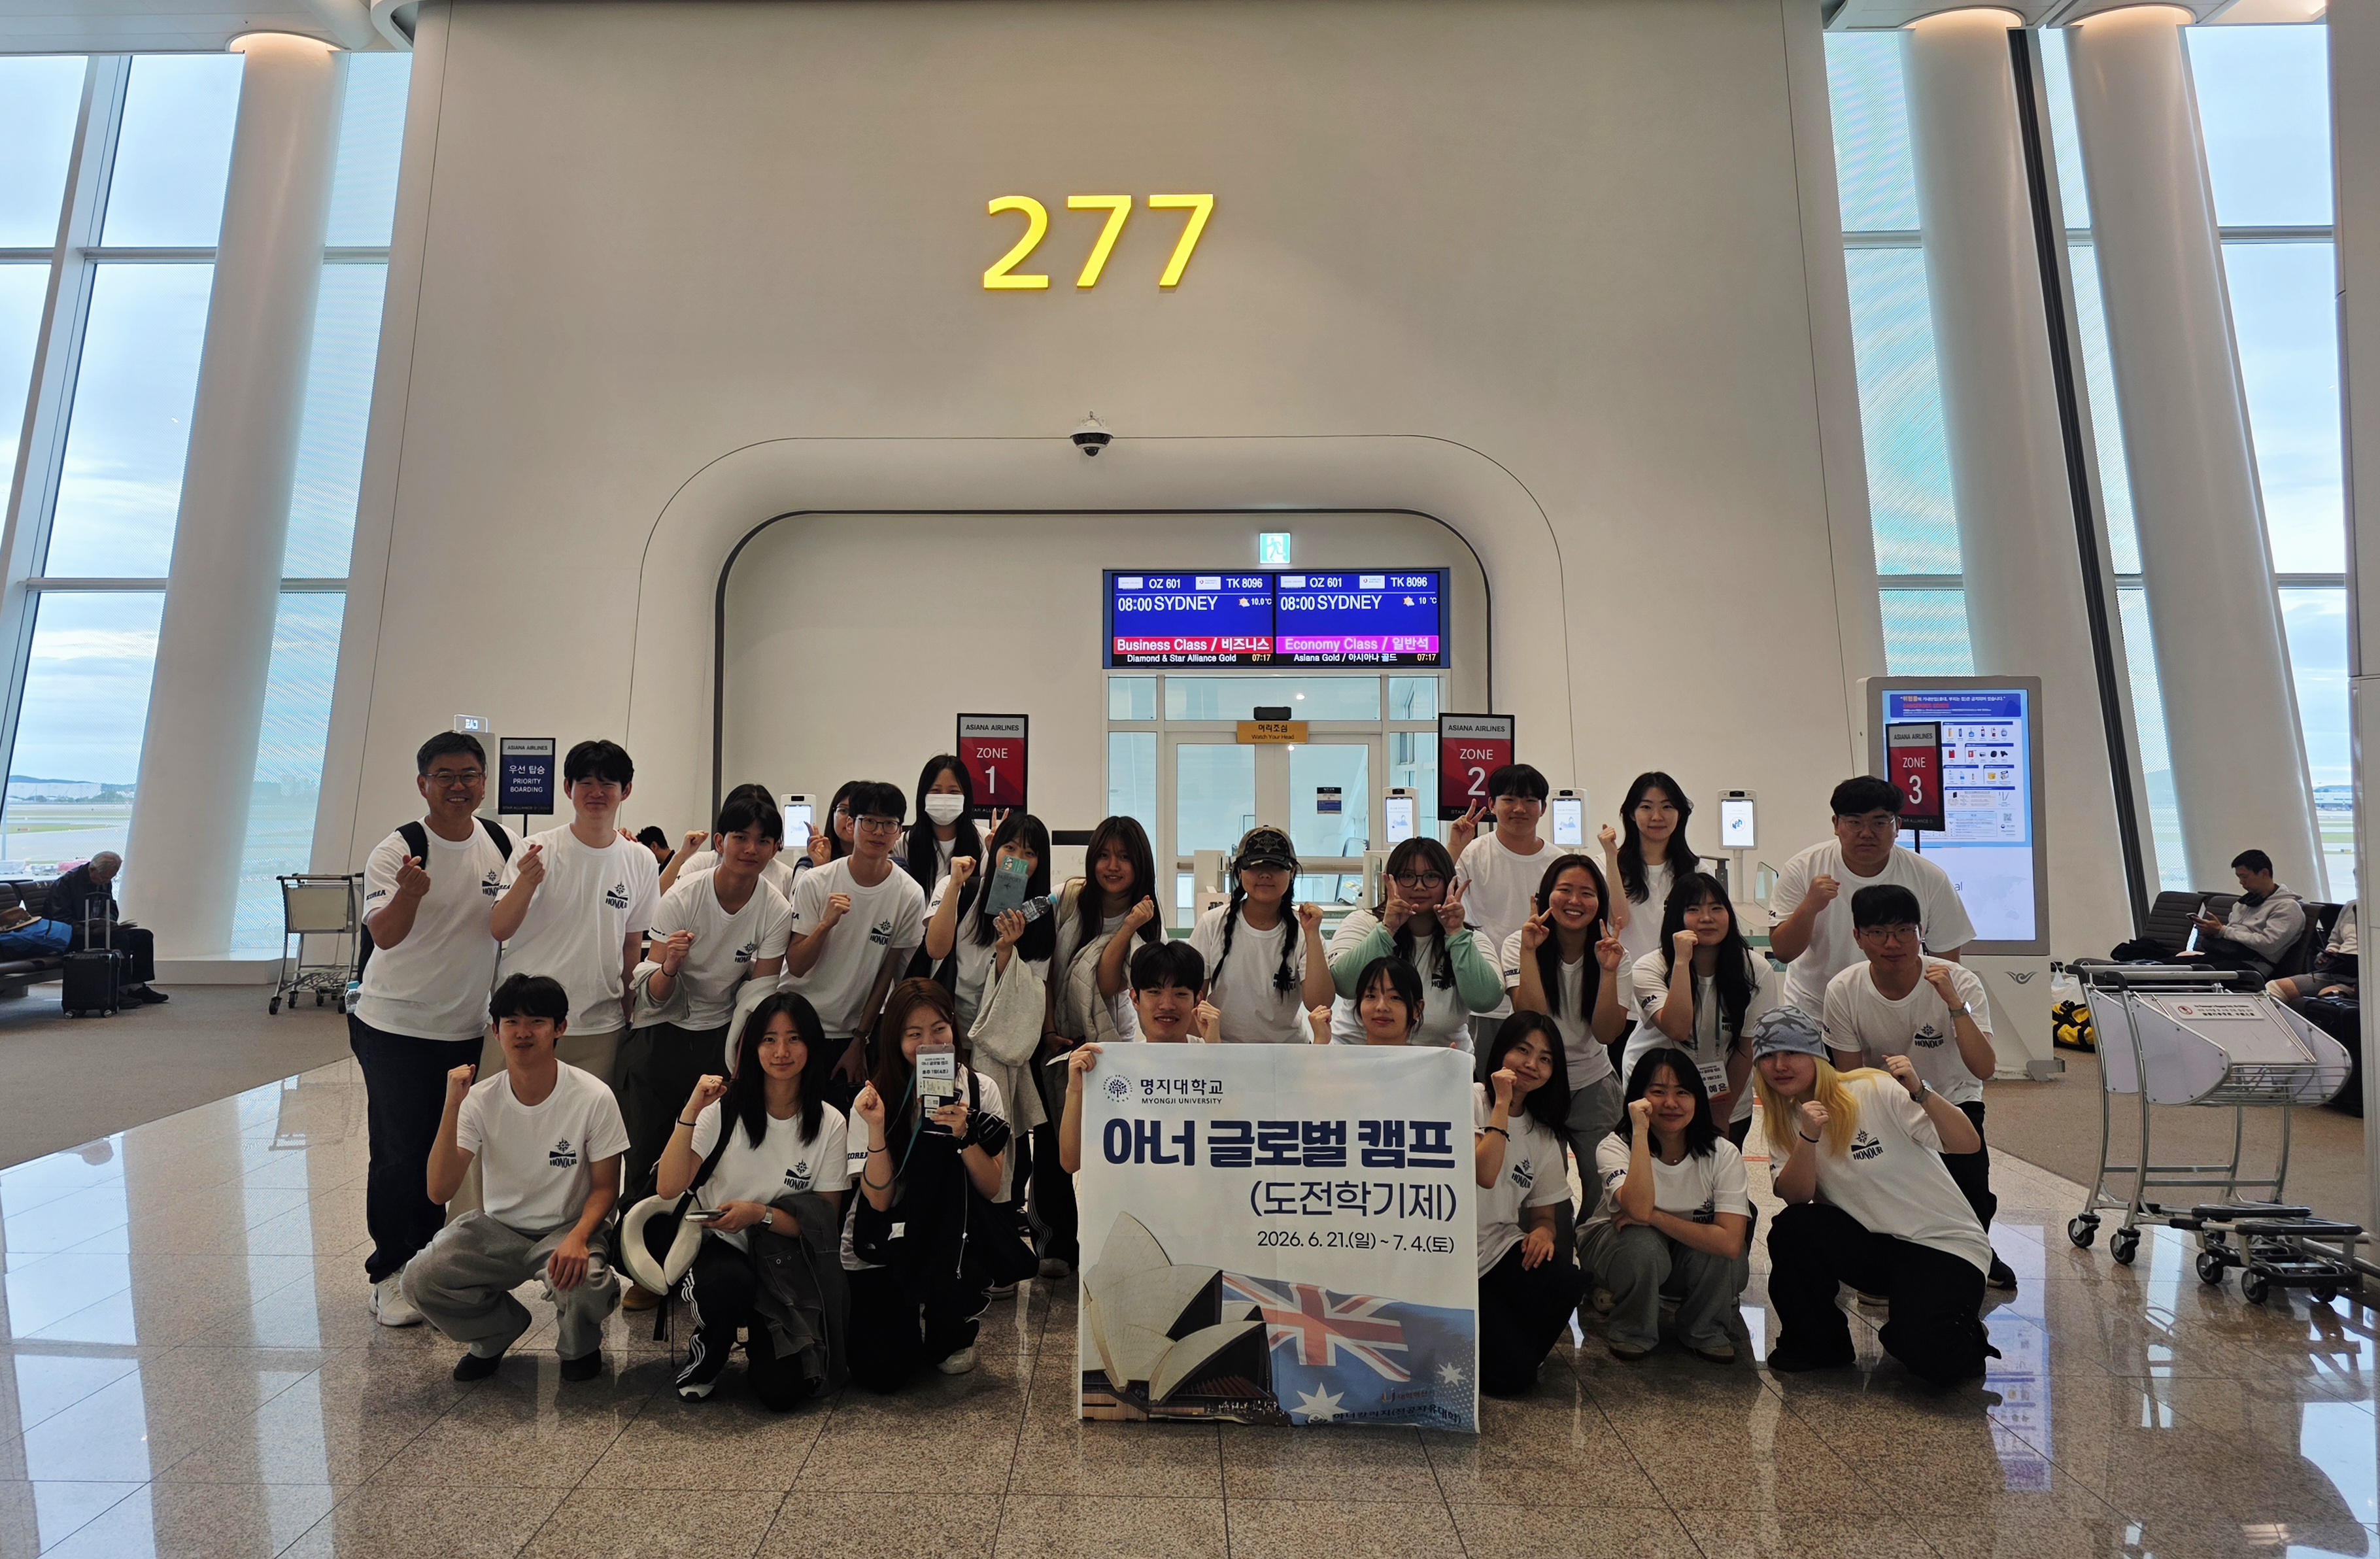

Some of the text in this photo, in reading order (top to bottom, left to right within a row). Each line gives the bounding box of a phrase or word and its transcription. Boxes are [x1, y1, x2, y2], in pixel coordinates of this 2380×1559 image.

[983, 193, 1214, 290] 277
[1149, 579, 1181, 589] OZ 601
[1226, 578, 1240, 588] TK
[1242, 578, 1263, 589] 8096
[1310, 577, 1342, 588] OZ 601
[1390, 577, 1404, 587] TK
[1406, 577, 1427, 587] 8096
[1118, 597, 1152, 611] 08:00
[1154, 596, 1218, 611] SYDNEY
[1280, 596, 1316, 611] 08:00
[1317, 595, 1382, 609] SYDNEY
[1117, 637, 1270, 651] Business Class / 비즈니스
[1285, 637, 1429, 653] Economy Class / 일반석
[1348, 653, 1380, 662] 아시아나
[1381, 653, 1397, 662] 골드
[1258, 724, 1288, 732] 머리조심
[976, 747, 1008, 759] ZONE
[1459, 748, 1493, 760] ZONE
[509, 764, 545, 774] 우선 탑승
[1902, 757, 1926, 768] ZONE
[985, 765, 995, 794] 1
[1467, 766, 1486, 796] 2
[1909, 775, 1922, 804] 3
[366, 889, 386, 900] KOREA
[1914, 1038, 1945, 1049] HONOUR
[1140, 1078, 1223, 1095] 명지대학교
[1103, 1118, 1456, 1169] 아너 글로벌 캠프
[1853, 1146, 1884, 1160] HONOUR
[549, 1157, 577, 1168] HONOUR
[784, 1178, 809, 1190] HONOUR
[1511, 1173, 1531, 1188] HONOUR
[1250, 1180, 1457, 1222] (도전학기제)
[1257, 1231, 1304, 1246] 2026.
[1308, 1231, 1323, 1246] 6.
[1327, 1231, 1376, 1250] 21.(일)
[1393, 1234, 1407, 1251] 7.
[1410, 1235, 1455, 1254] 4.(토)
